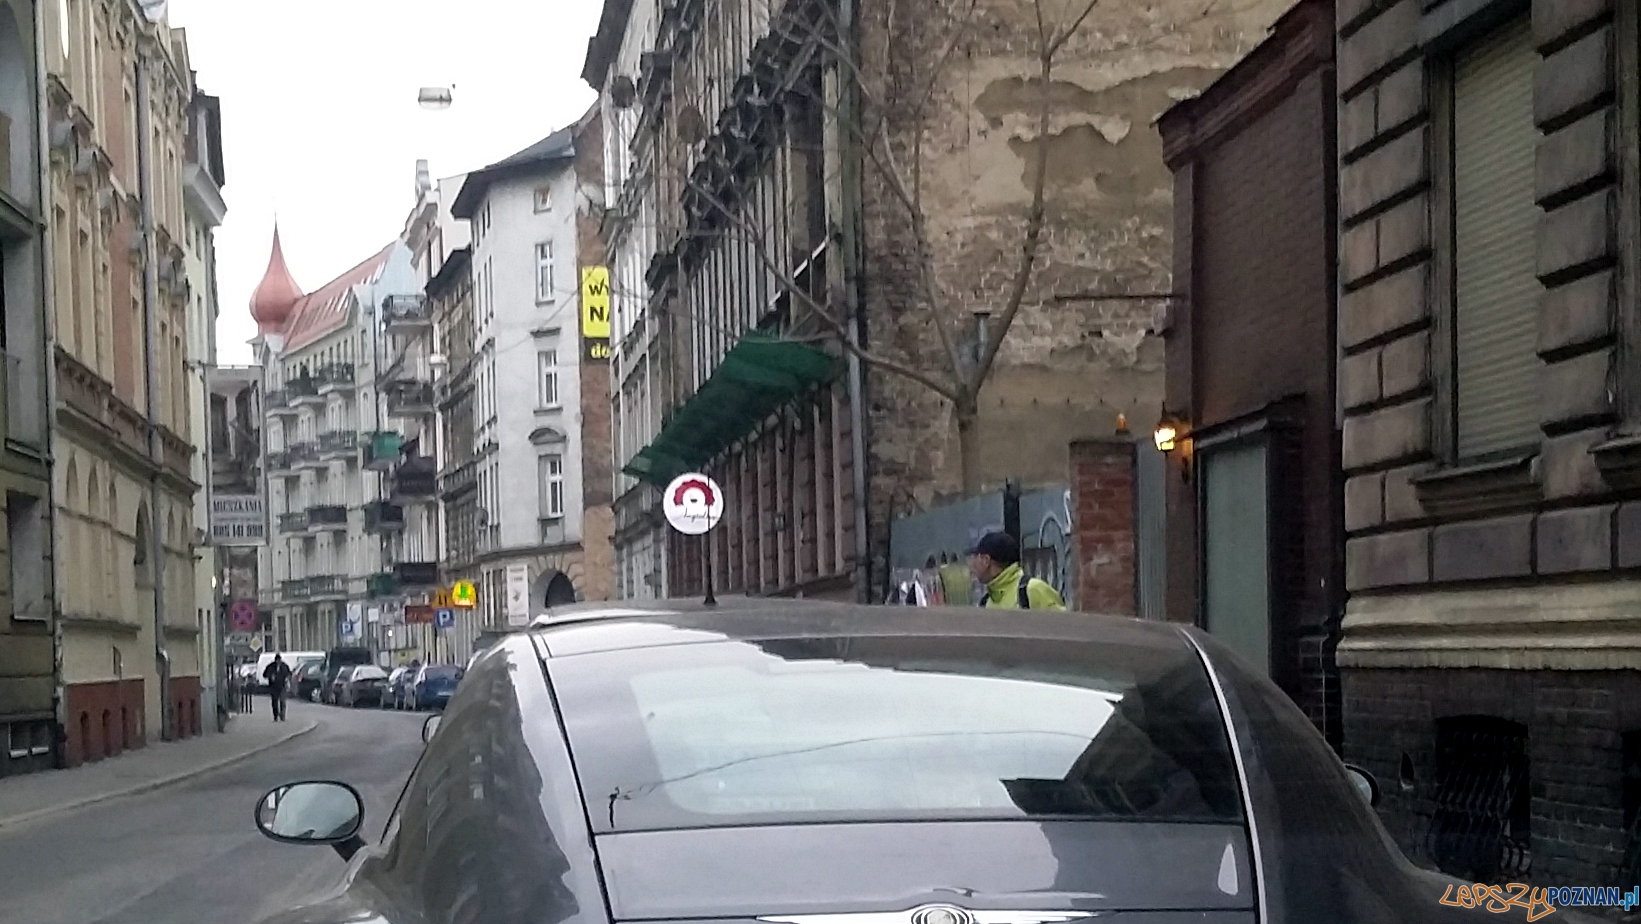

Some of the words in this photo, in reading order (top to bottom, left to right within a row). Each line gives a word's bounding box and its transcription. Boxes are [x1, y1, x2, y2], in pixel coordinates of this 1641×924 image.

[213, 499, 262, 513] MIESZKANIA
[438, 610, 450, 626] P
[342, 623, 351, 634] P
